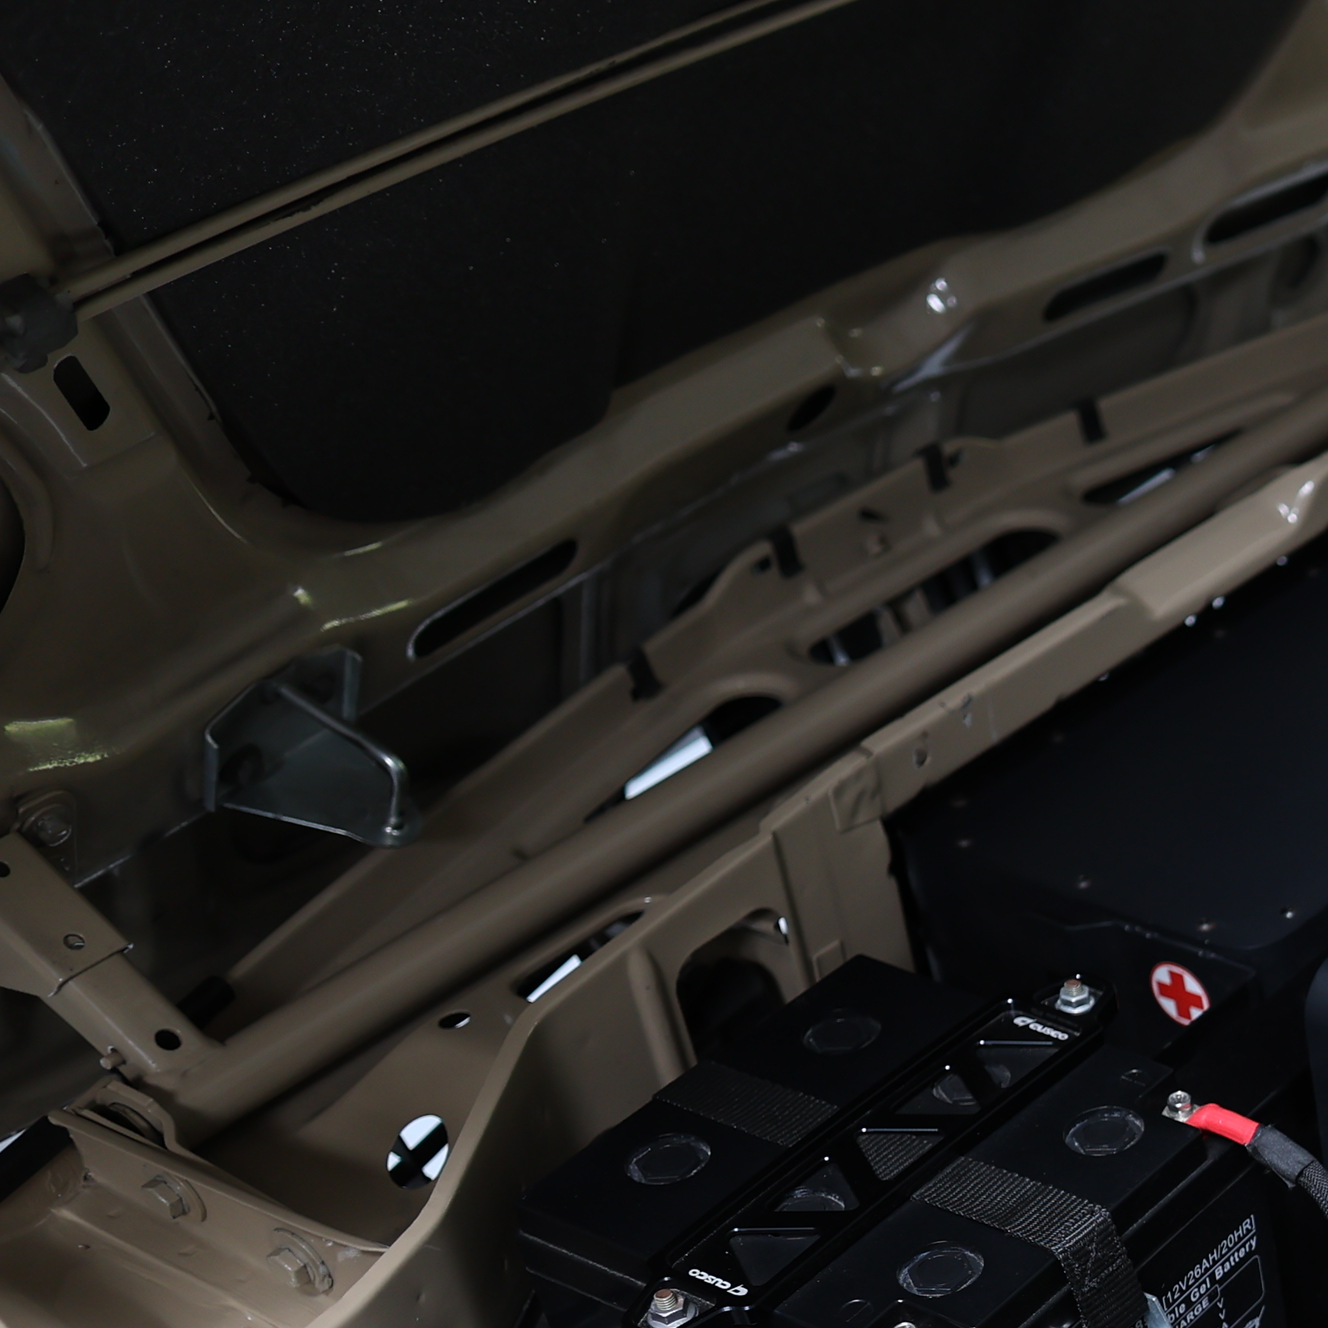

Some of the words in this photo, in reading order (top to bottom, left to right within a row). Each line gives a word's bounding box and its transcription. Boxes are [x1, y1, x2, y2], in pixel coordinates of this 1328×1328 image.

[688, 1268, 732, 1289] CUSCO
[1162, 1213, 1256, 1311] [12V26AH/20HR]
[1190, 1277, 1211, 1302] Gel
[1214, 1235, 1257, 1281] Battery
